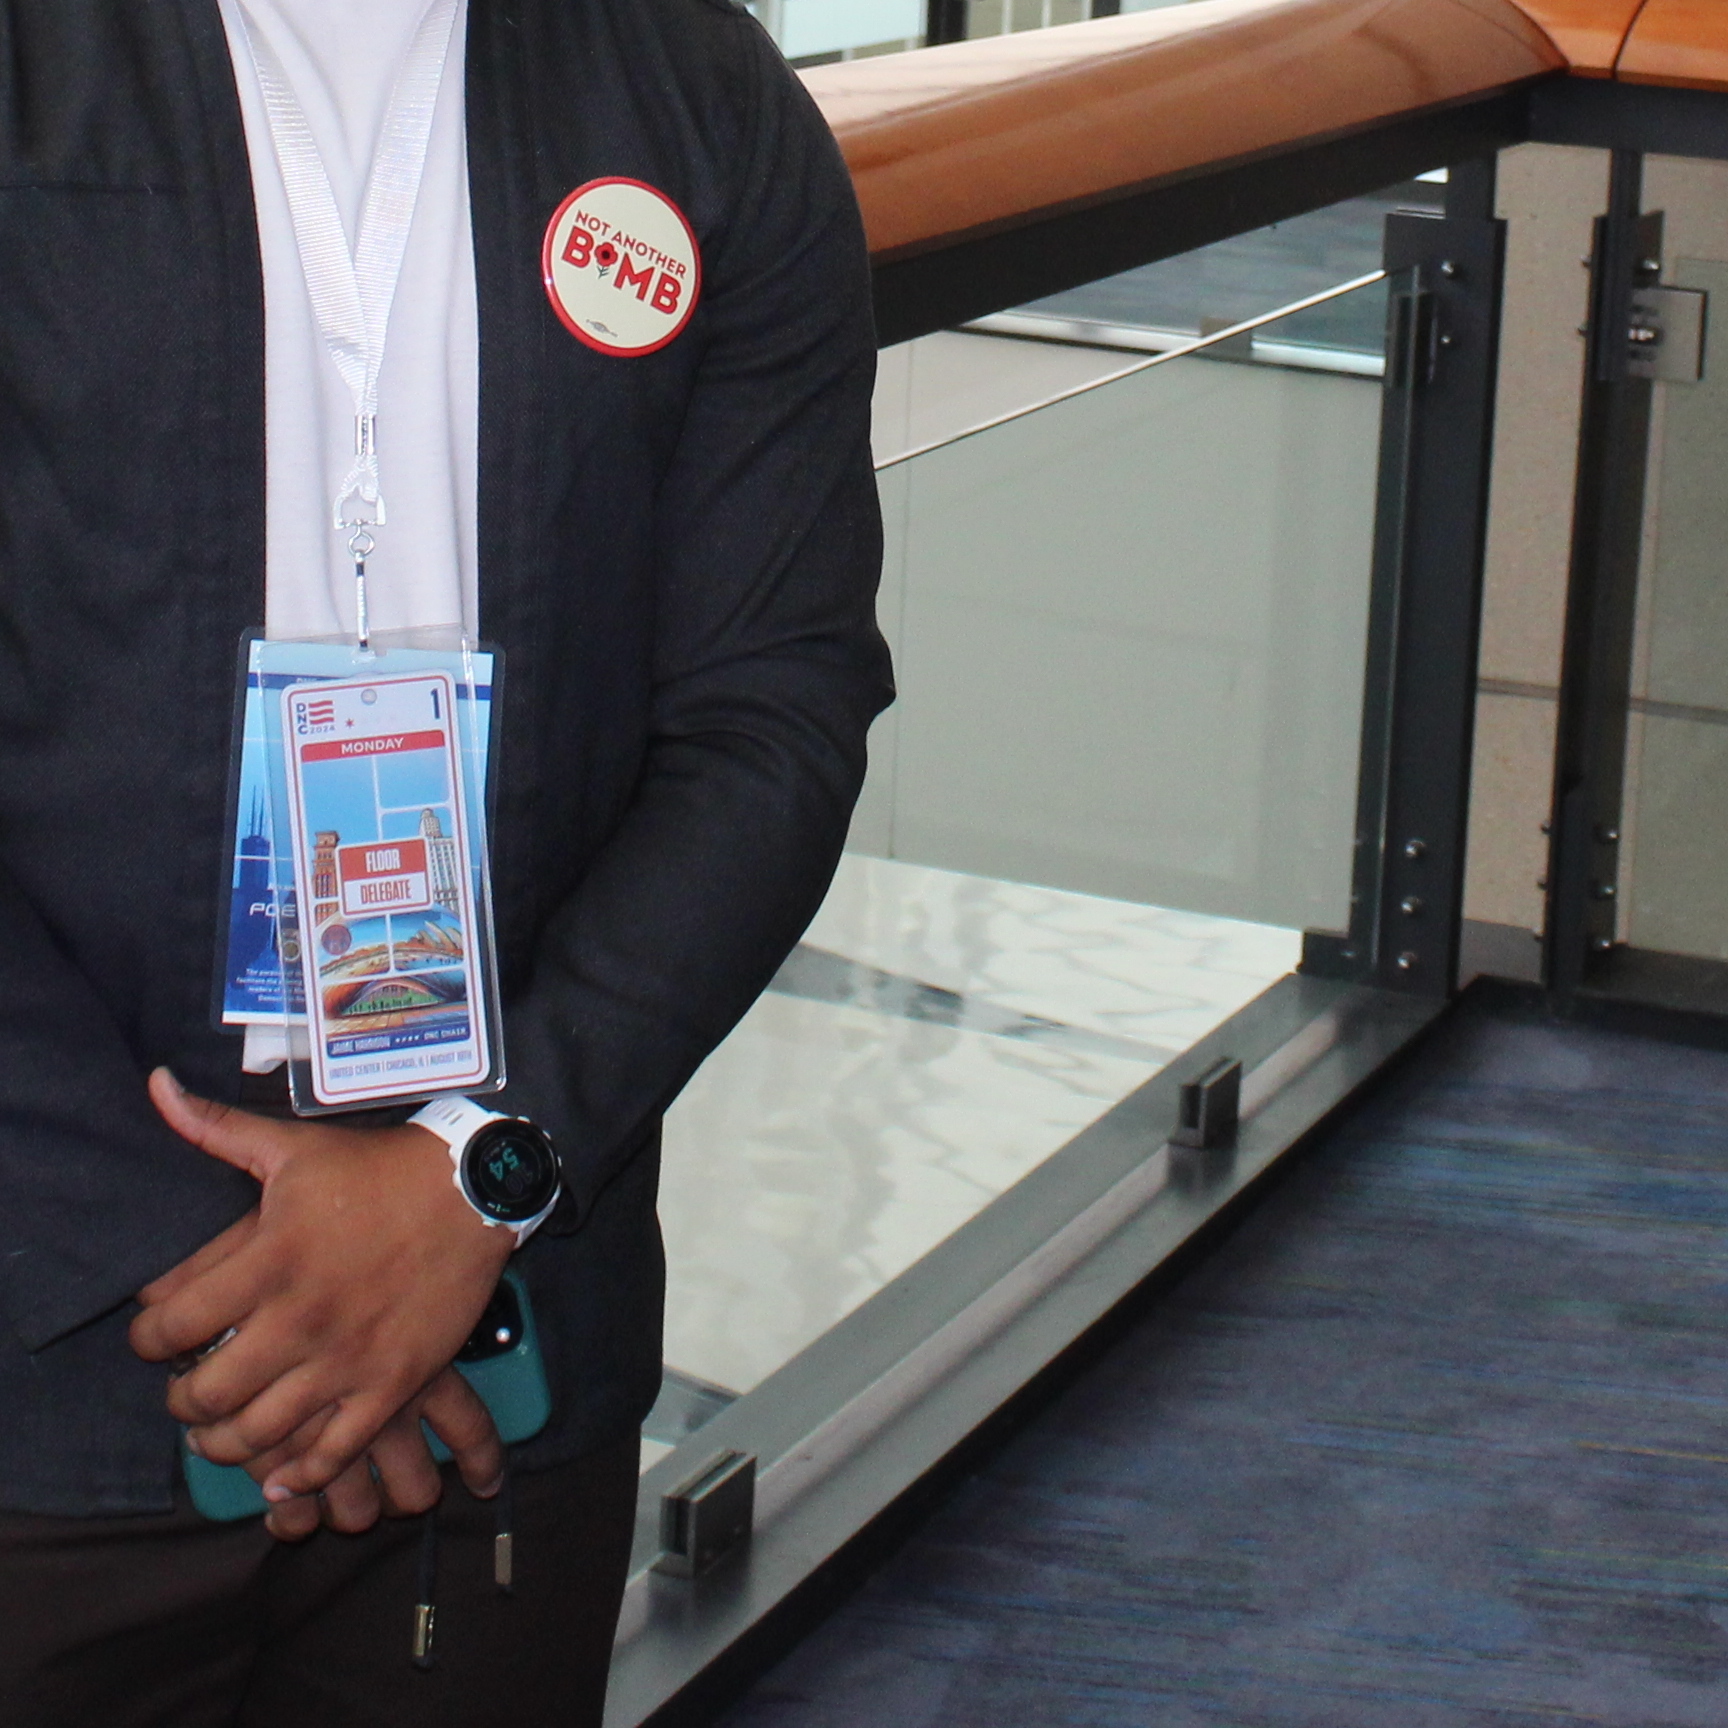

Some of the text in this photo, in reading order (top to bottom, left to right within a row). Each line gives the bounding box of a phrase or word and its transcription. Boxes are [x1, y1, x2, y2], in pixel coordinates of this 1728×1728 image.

[574, 209, 687, 279] NOT ANOTHER
[430, 688, 440, 719] 1
[309, 724, 336, 734] 2024
[341, 737, 404, 755] MONDAY
[365, 848, 400, 873] FLOOR
[360, 879, 411, 904] DELEGATE
